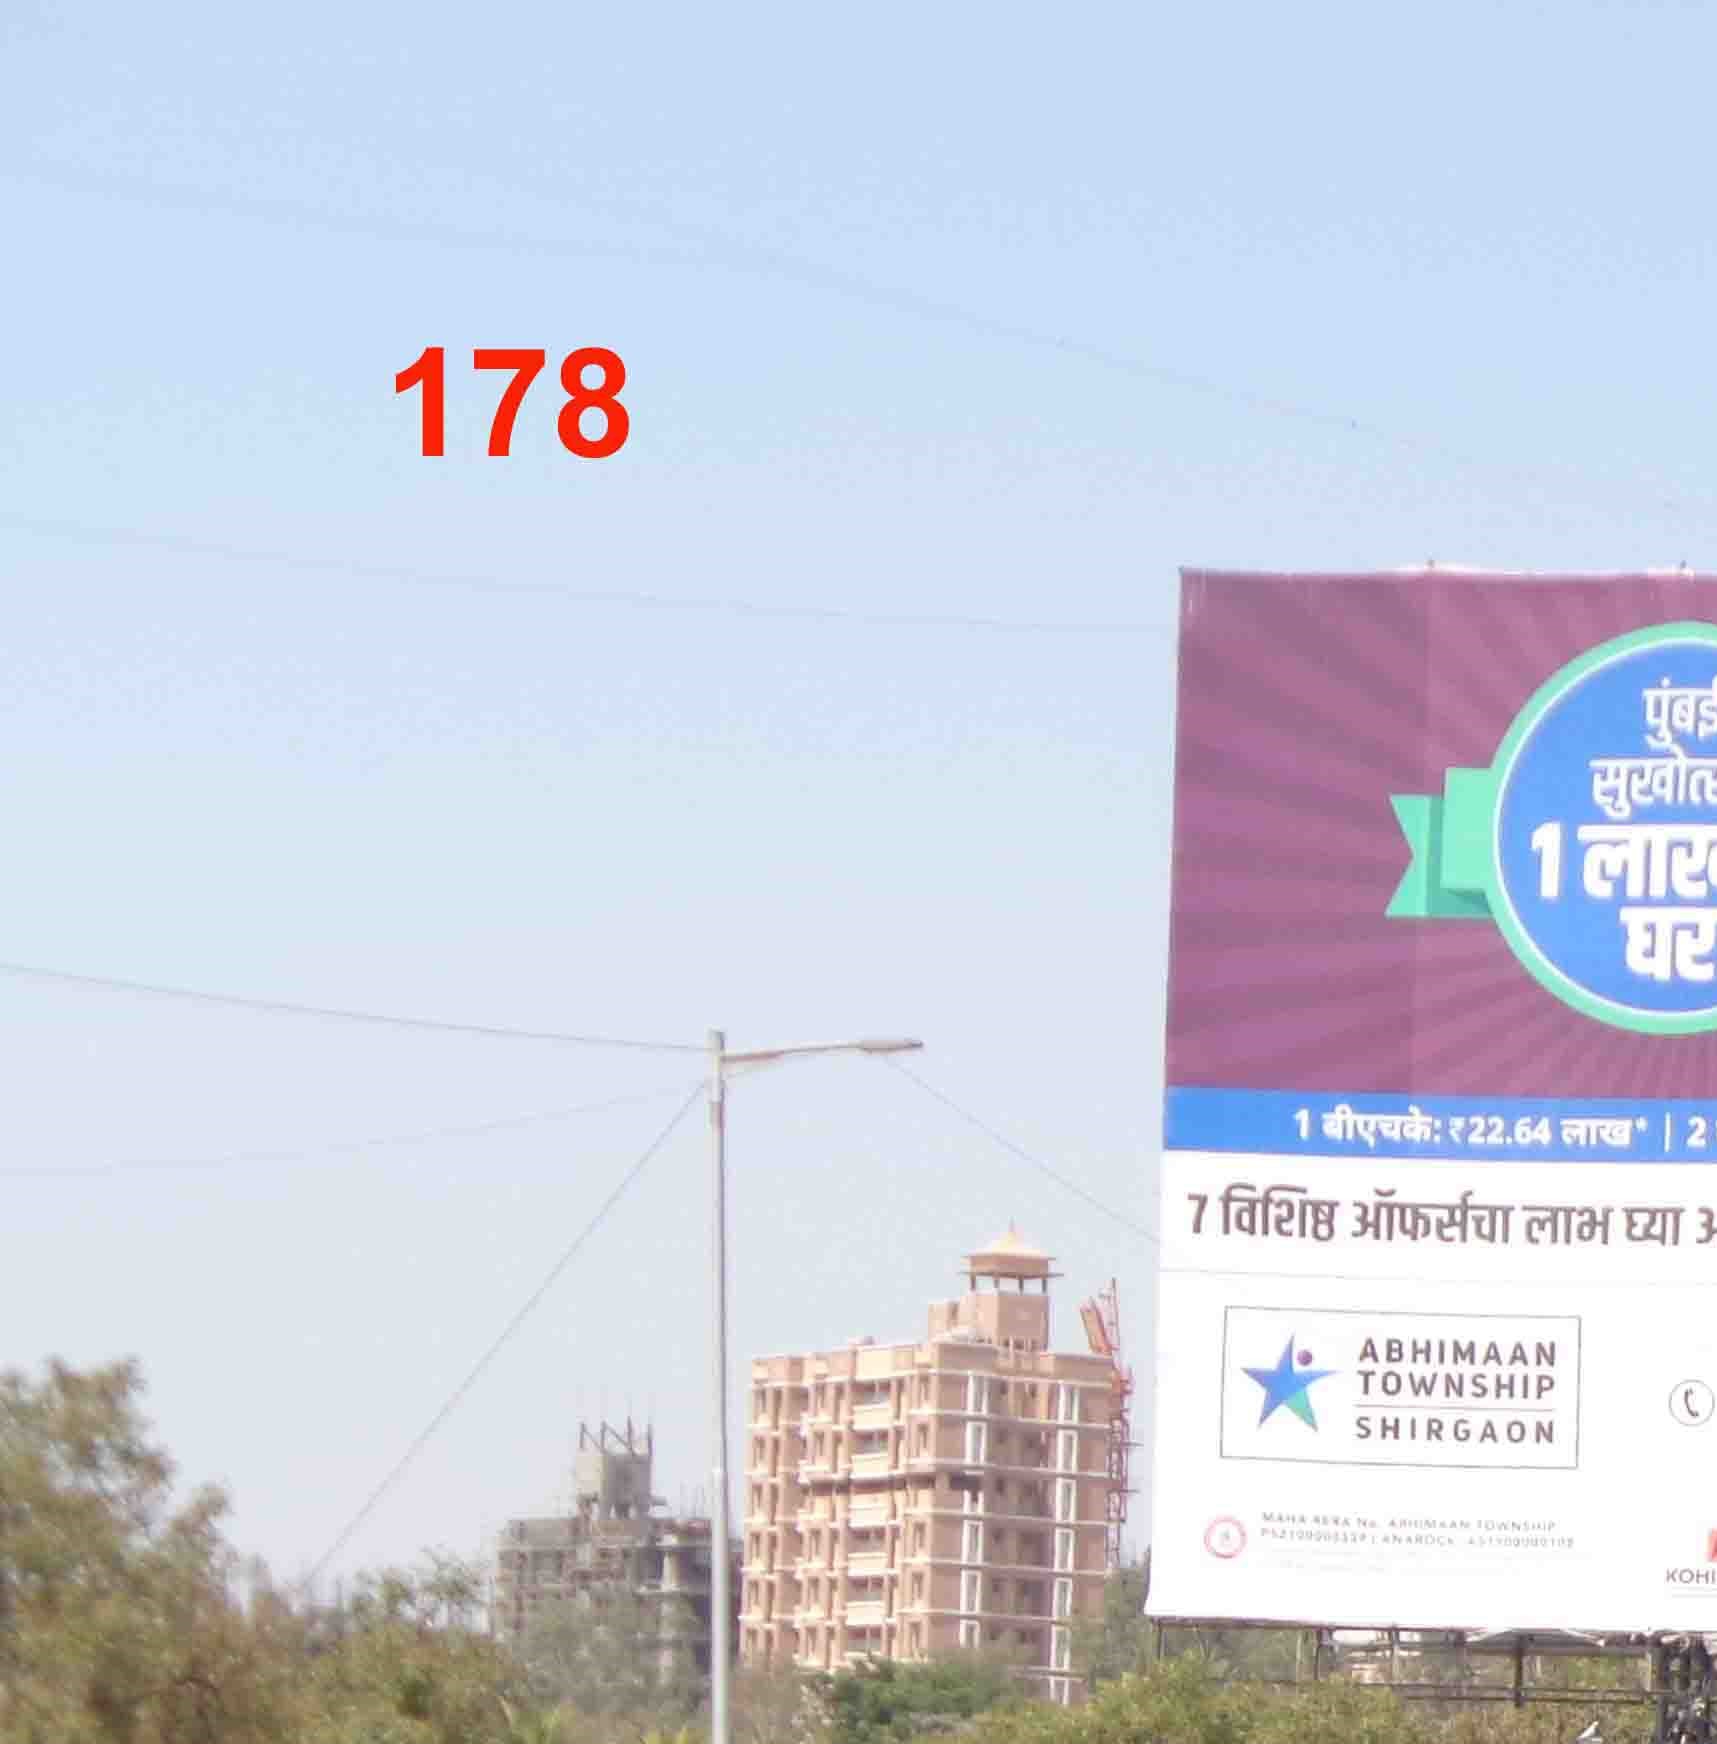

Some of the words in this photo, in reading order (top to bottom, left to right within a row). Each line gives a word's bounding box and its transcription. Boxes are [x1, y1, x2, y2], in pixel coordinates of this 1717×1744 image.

[1531, 822, 1562, 899] 1
[1294, 1109, 1310, 1140] 1
[1449, 1115, 1551, 1146] ₹22.64
[1686, 1116, 1708, 1148] 2
[1187, 1193, 1209, 1234] 7
[1351, 1187, 1516, 1245] ऑफर्सचा
[1522, 1204, 1613, 1246] लाभ
[1622, 1206, 1686, 1248] घ्या
[1357, 1337, 1557, 1368] ABHIMAAN
[1356, 1369, 1556, 1400] TOWNSHIP
[1355, 1416, 1556, 1444] SHIRGAON
